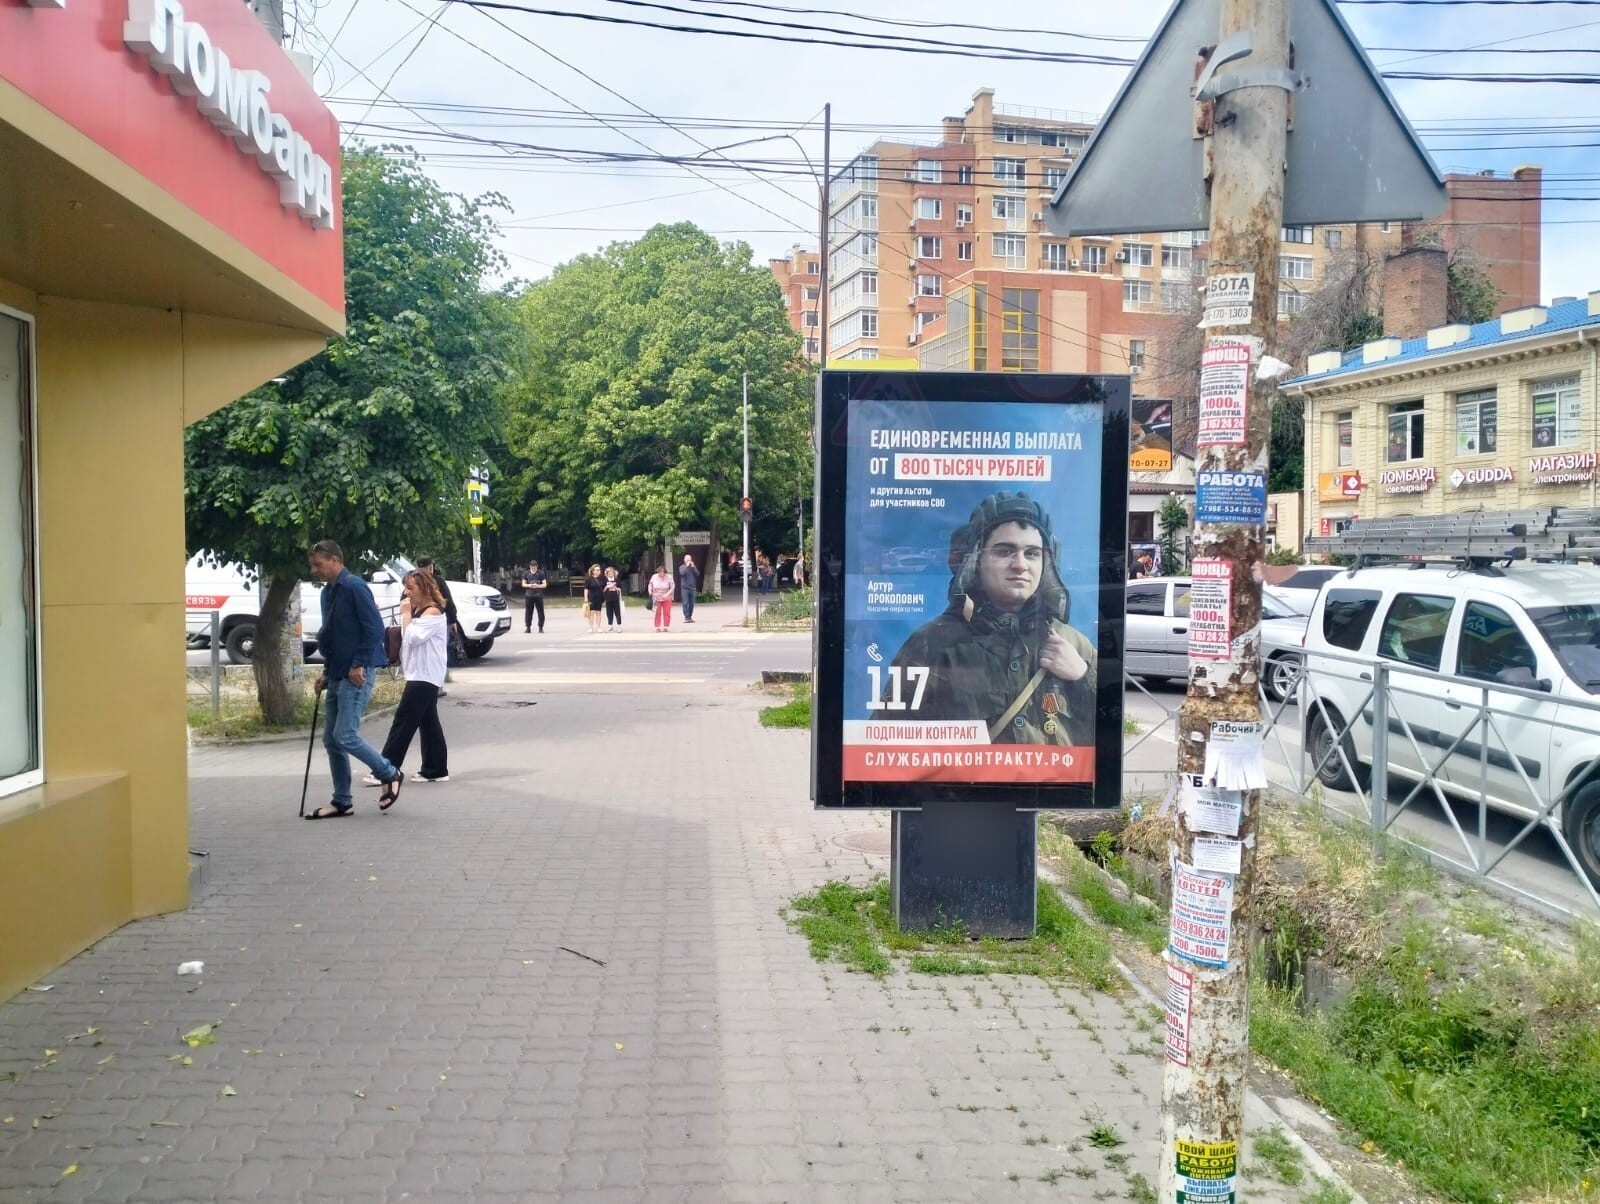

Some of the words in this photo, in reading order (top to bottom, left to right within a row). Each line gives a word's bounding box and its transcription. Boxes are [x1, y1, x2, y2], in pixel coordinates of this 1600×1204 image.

[870, 429, 1011, 450] ЕДИНОВРЕМЕННАЯ
[1015, 432, 1082, 450] ВЫПЛАТА
[869, 458, 888, 475] ОТ
[901, 458, 930, 476] 800
[933, 458, 984, 476] ТЫСЯЧ
[988, 456, 1045, 477] РУБЛЕЙ
[1529, 453, 1597, 472] МАГАЗИН
[1199, 473, 1264, 488] РАБОТА
[1379, 467, 1436, 484] ЛОМБАРД
[1467, 467, 1513, 483] GUDDA
[1531, 471, 1593, 484] электроники
[876, 488, 903, 497] другие
[904, 488, 932, 496] льготы
[870, 498, 884, 507] для
[886, 499, 929, 509] участников
[930, 498, 945, 507] СВО
[867, 580, 894, 593] Артур
[185, 596, 216, 605] СВЯЗЬ
[867, 593, 924, 604] ПРОКОПОВИЧ
[866, 666, 930, 710] 117
[865, 726, 923, 741] ПОДПИШИ
[926, 726, 979, 740] КОНТРАКТ
[865, 751, 1074, 768] СЛУЖБАПОКОНТРАКТУ.РФ
[1178, 1143, 1206, 1156] ТВОЙ
[1209, 1145, 1236, 1157] ШАНС
[1180, 1154, 1234, 1167] РАБОТА
